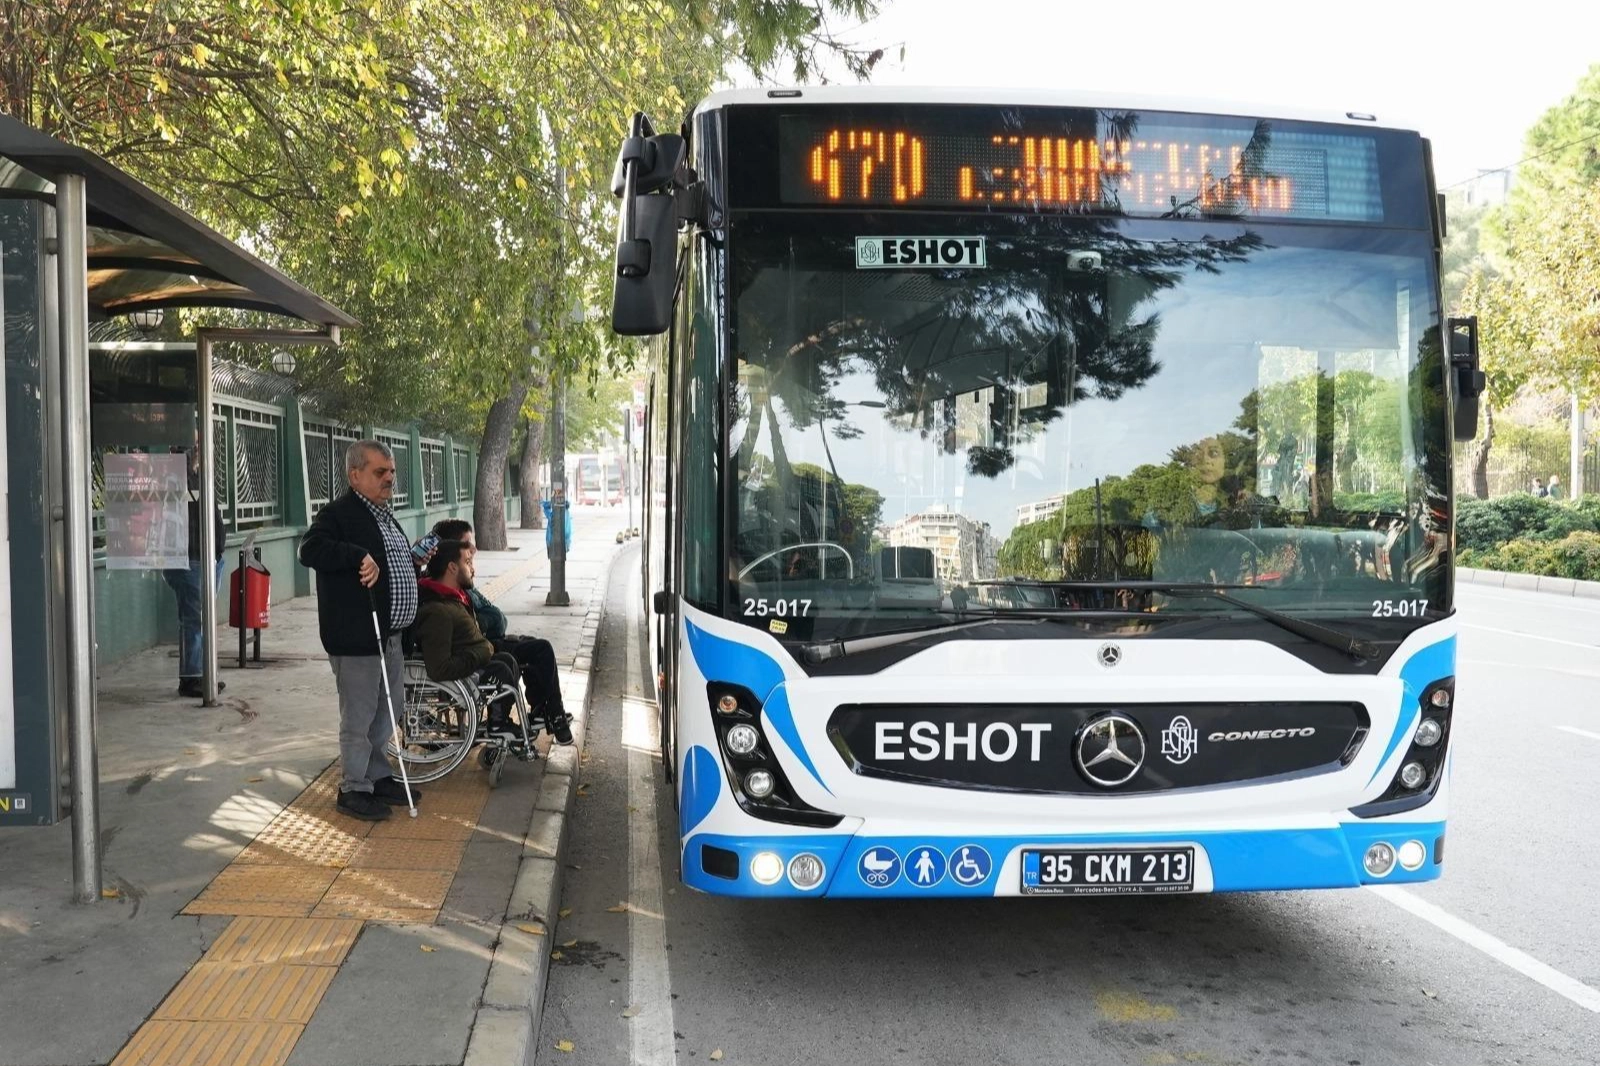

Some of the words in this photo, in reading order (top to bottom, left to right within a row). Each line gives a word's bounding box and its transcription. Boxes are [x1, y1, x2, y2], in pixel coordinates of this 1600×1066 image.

[882, 239, 980, 264] ESHOT
[743, 598, 812, 617] 25-017
[1372, 599, 1428, 617] 25-017
[875, 721, 1052, 762] ESHOT
[1208, 727, 1316, 742] CONECTO
[1026, 872, 1037, 880] TR
[1042, 855, 1073, 883] 35
[1085, 855, 1131, 882] CKM
[1142, 854, 1187, 882] 213
